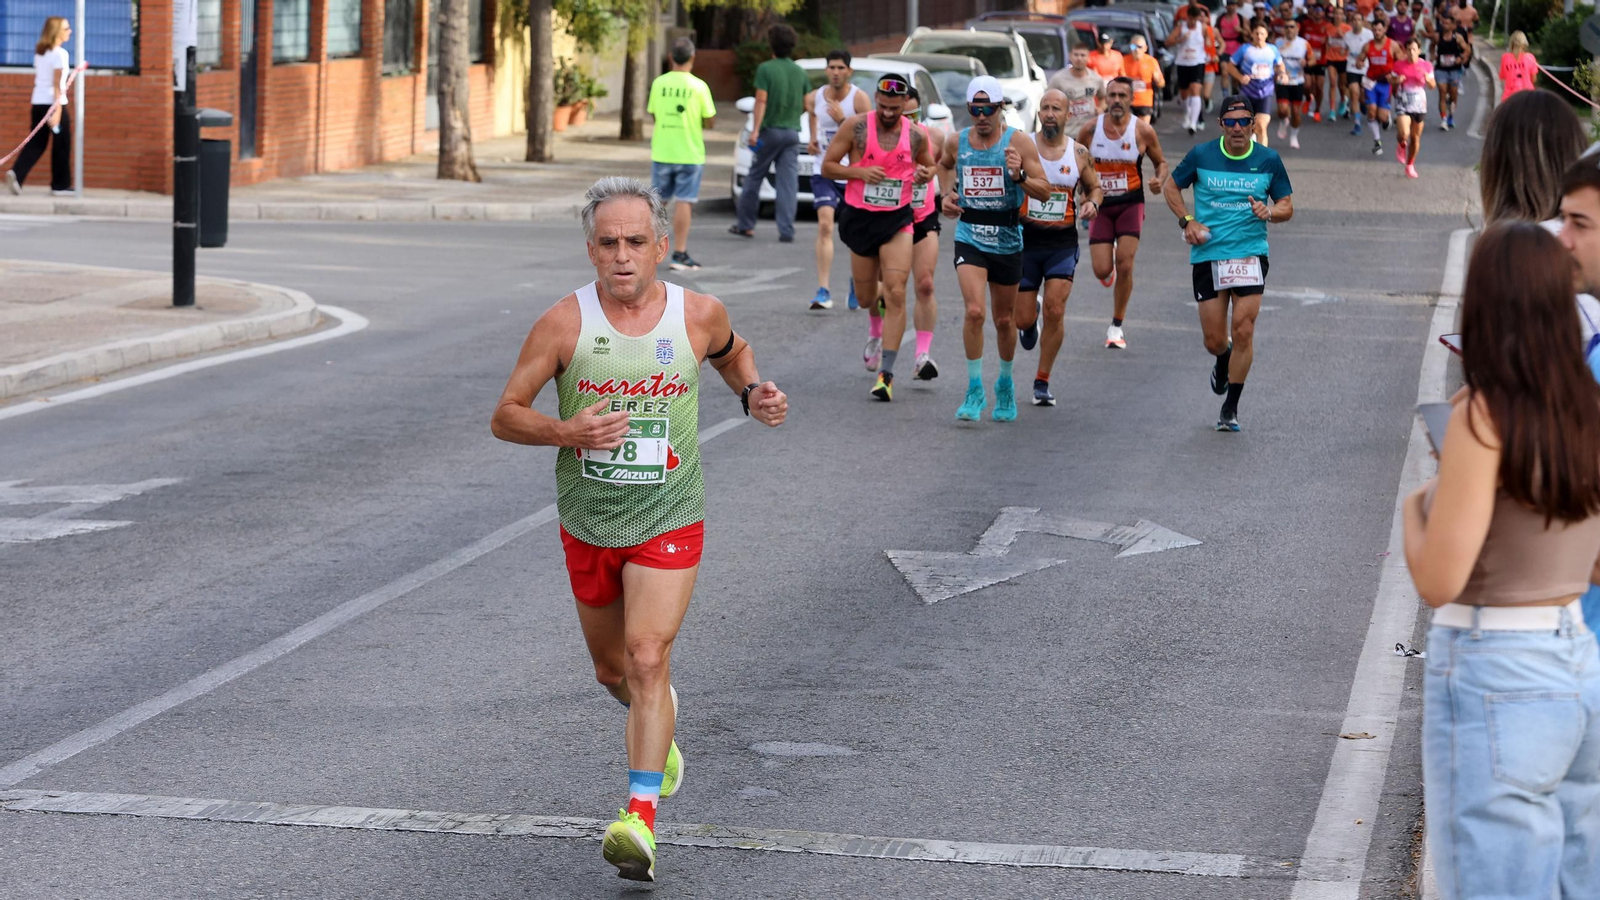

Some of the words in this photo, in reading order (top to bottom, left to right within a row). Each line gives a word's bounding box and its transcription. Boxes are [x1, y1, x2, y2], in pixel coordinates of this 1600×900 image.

[973, 177, 993, 187] 537
[1207, 177, 1257, 189] NutreTec
[875, 187, 893, 197] 120
[1041, 202, 1054, 211] 97
[1228, 265, 1248, 275] 465
[577, 371, 690, 398] maratón
[611, 400, 669, 414] EREZ
[609, 441, 637, 462] 98
